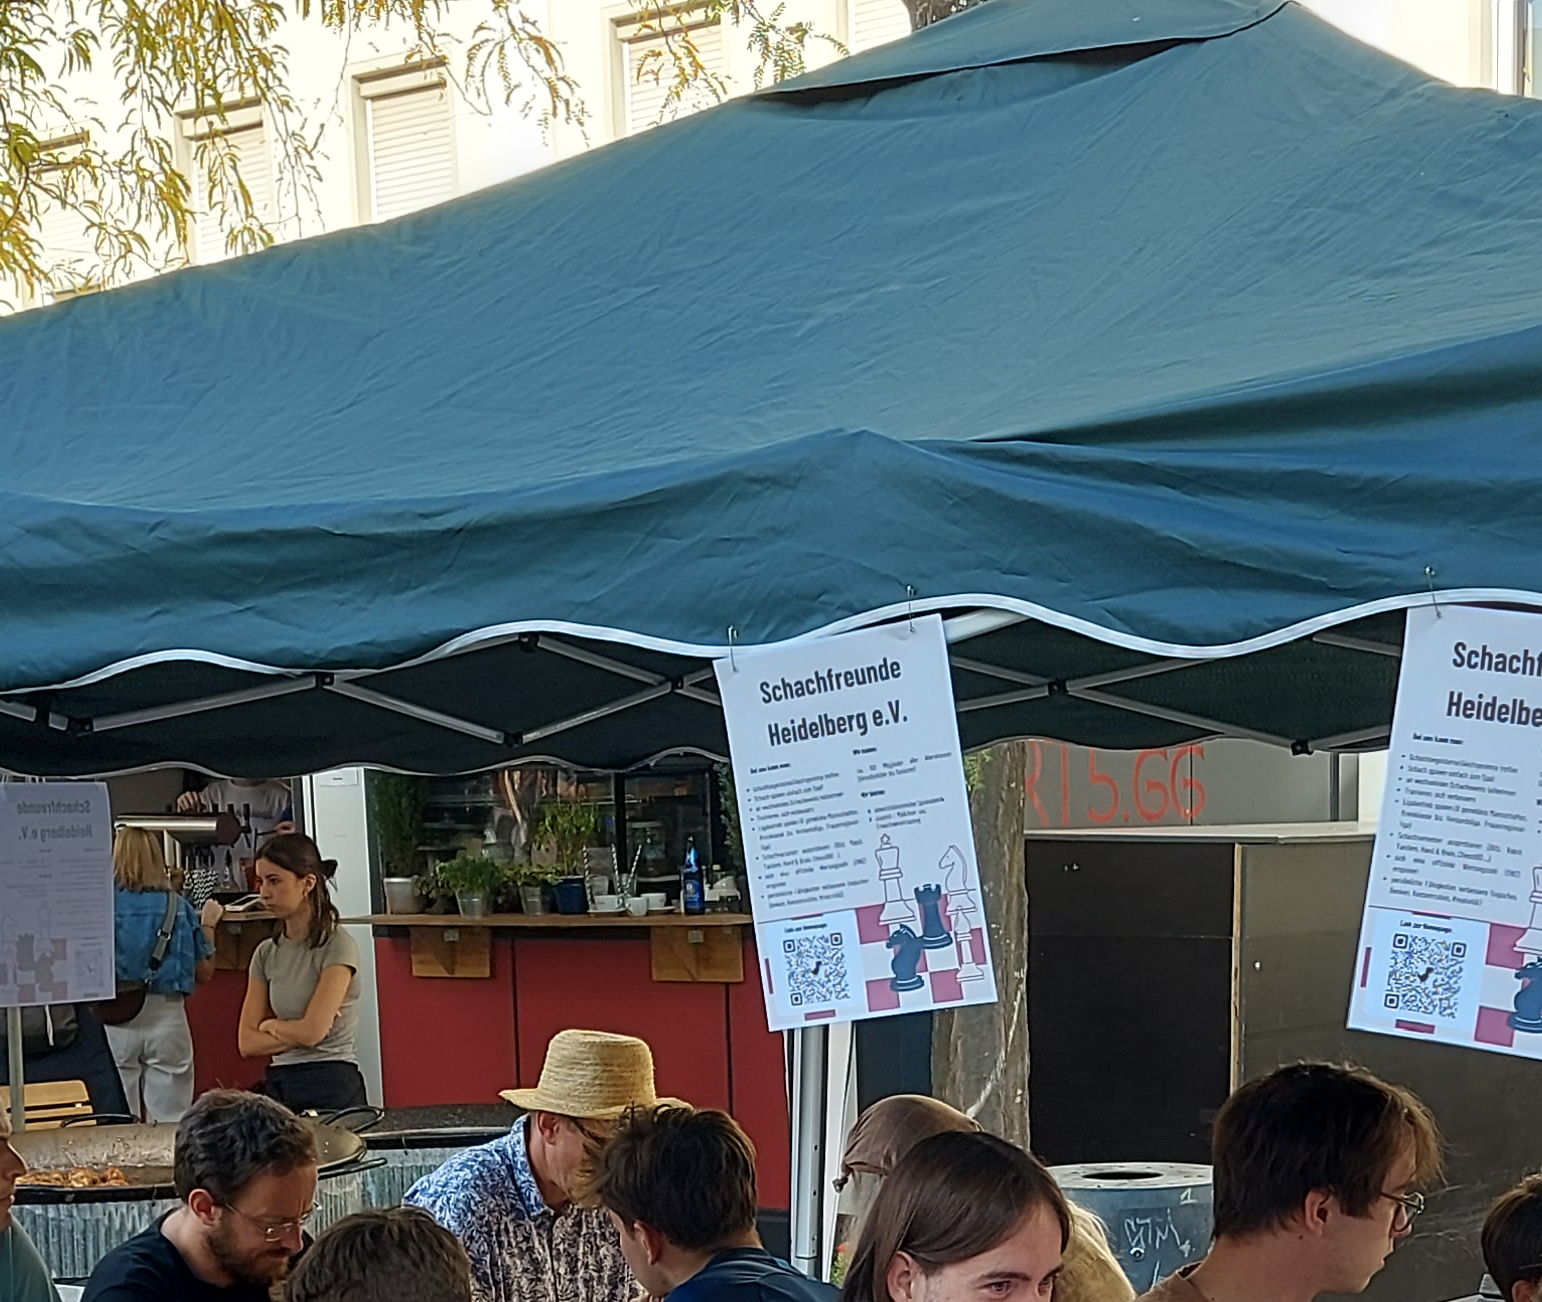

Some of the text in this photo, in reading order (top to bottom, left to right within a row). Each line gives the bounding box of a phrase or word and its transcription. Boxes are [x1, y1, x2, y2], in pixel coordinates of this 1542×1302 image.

[759, 657, 902, 704] Schachfreunde
[767, 699, 908, 747] Heidelberg e.V.
